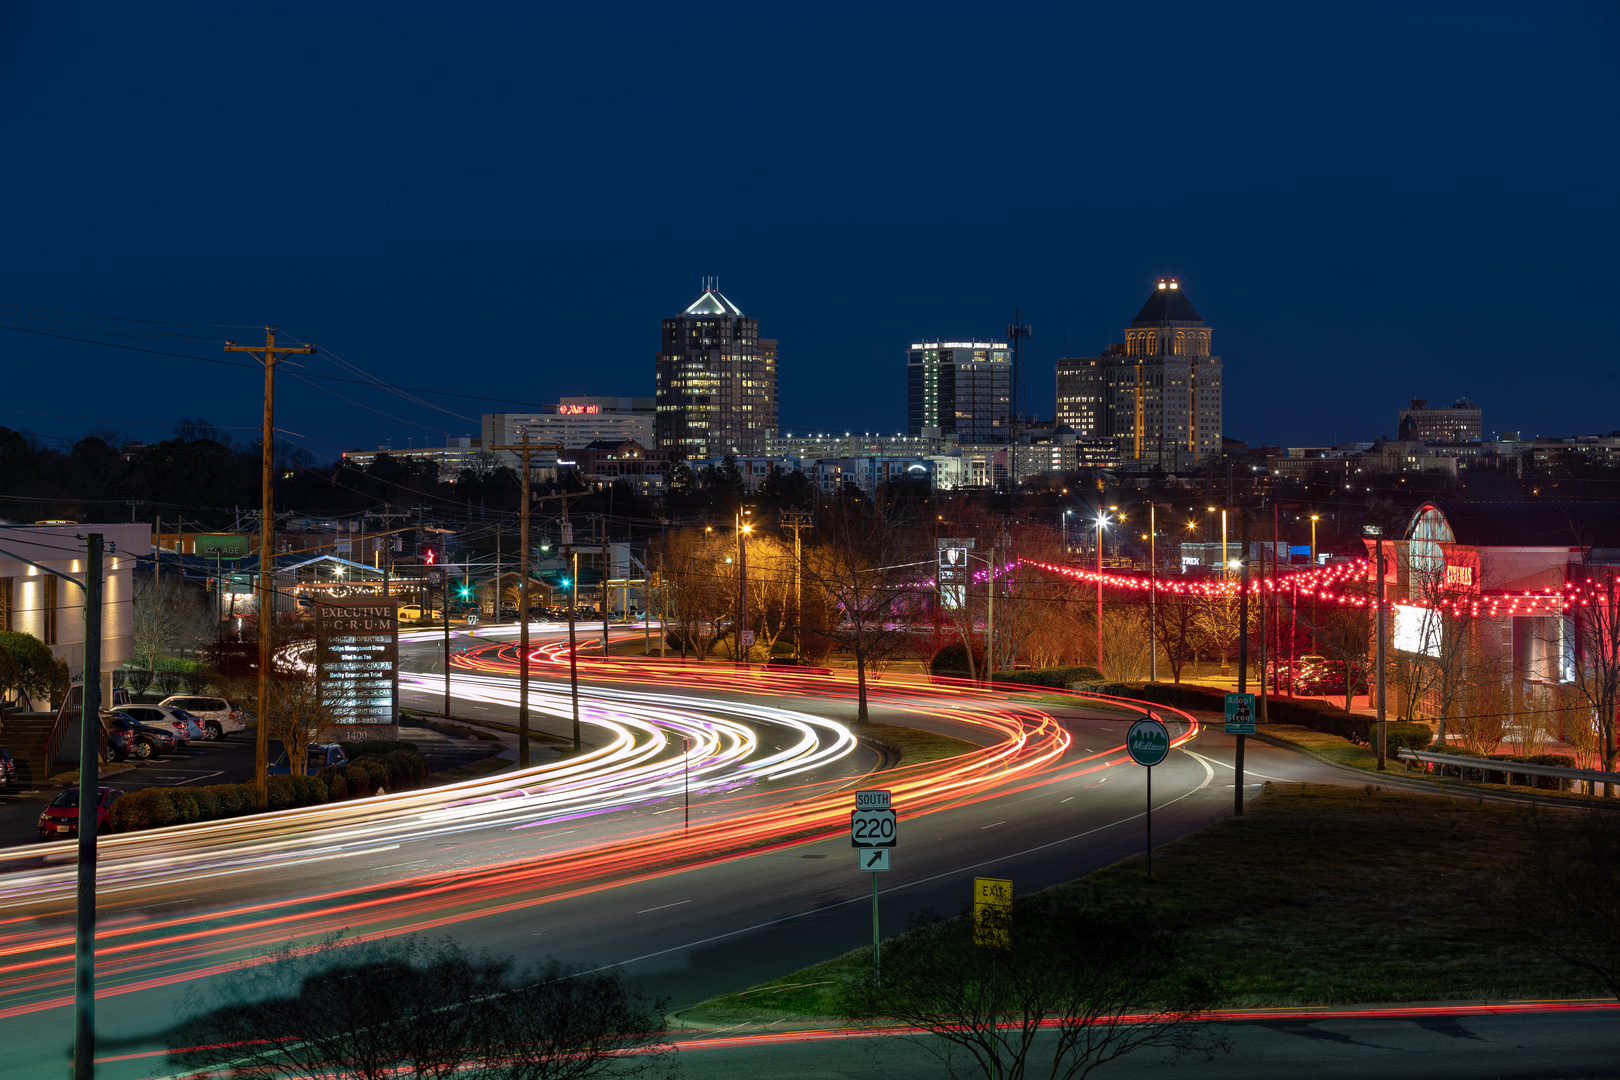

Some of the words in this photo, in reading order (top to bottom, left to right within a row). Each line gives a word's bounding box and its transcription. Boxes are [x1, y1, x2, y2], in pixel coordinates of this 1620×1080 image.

[567, 405, 599, 415] Mariott
[1182, 556, 1200, 566] TREK
[321, 607, 391, 618] EXECUTIVE
[371, 644, 385, 652] Group
[1227, 696, 1252, 705] Adopt
[1226, 713, 1254, 722] Street
[346, 731, 368, 740] 1400
[1132, 740, 1165, 751] Midtown
[857, 794, 889, 805] SOUTH
[854, 818, 894, 838] 220
[982, 885, 1003, 898] EXIT
